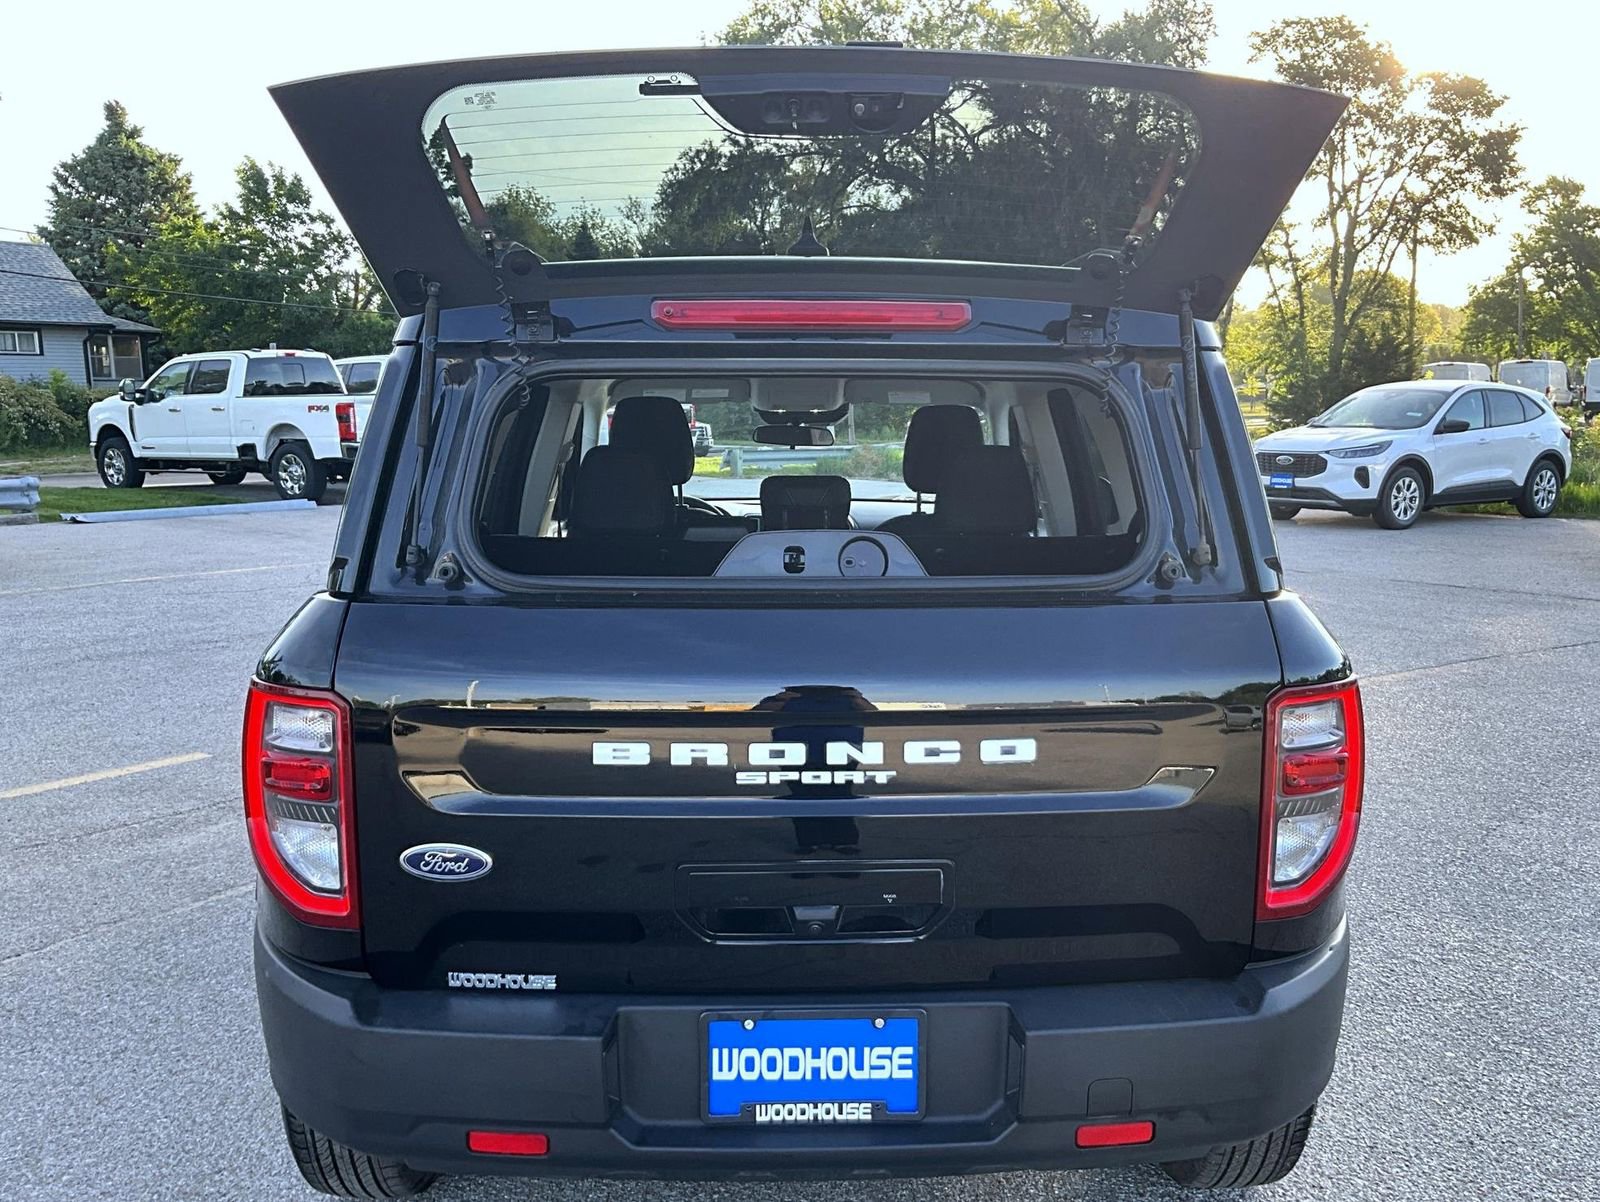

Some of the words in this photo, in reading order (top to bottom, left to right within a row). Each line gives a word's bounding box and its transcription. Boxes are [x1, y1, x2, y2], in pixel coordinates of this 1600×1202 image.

[308, 405, 329, 413] FX4
[593, 738, 1037, 765] BRONCO
[735, 770, 897, 785] SPORT
[420, 851, 469, 872] Ford
[448, 971, 557, 990] WOODHOUSE
[711, 1047, 913, 1081] WOODHOUSE
[755, 1103, 872, 1121] WOODHOUSE
